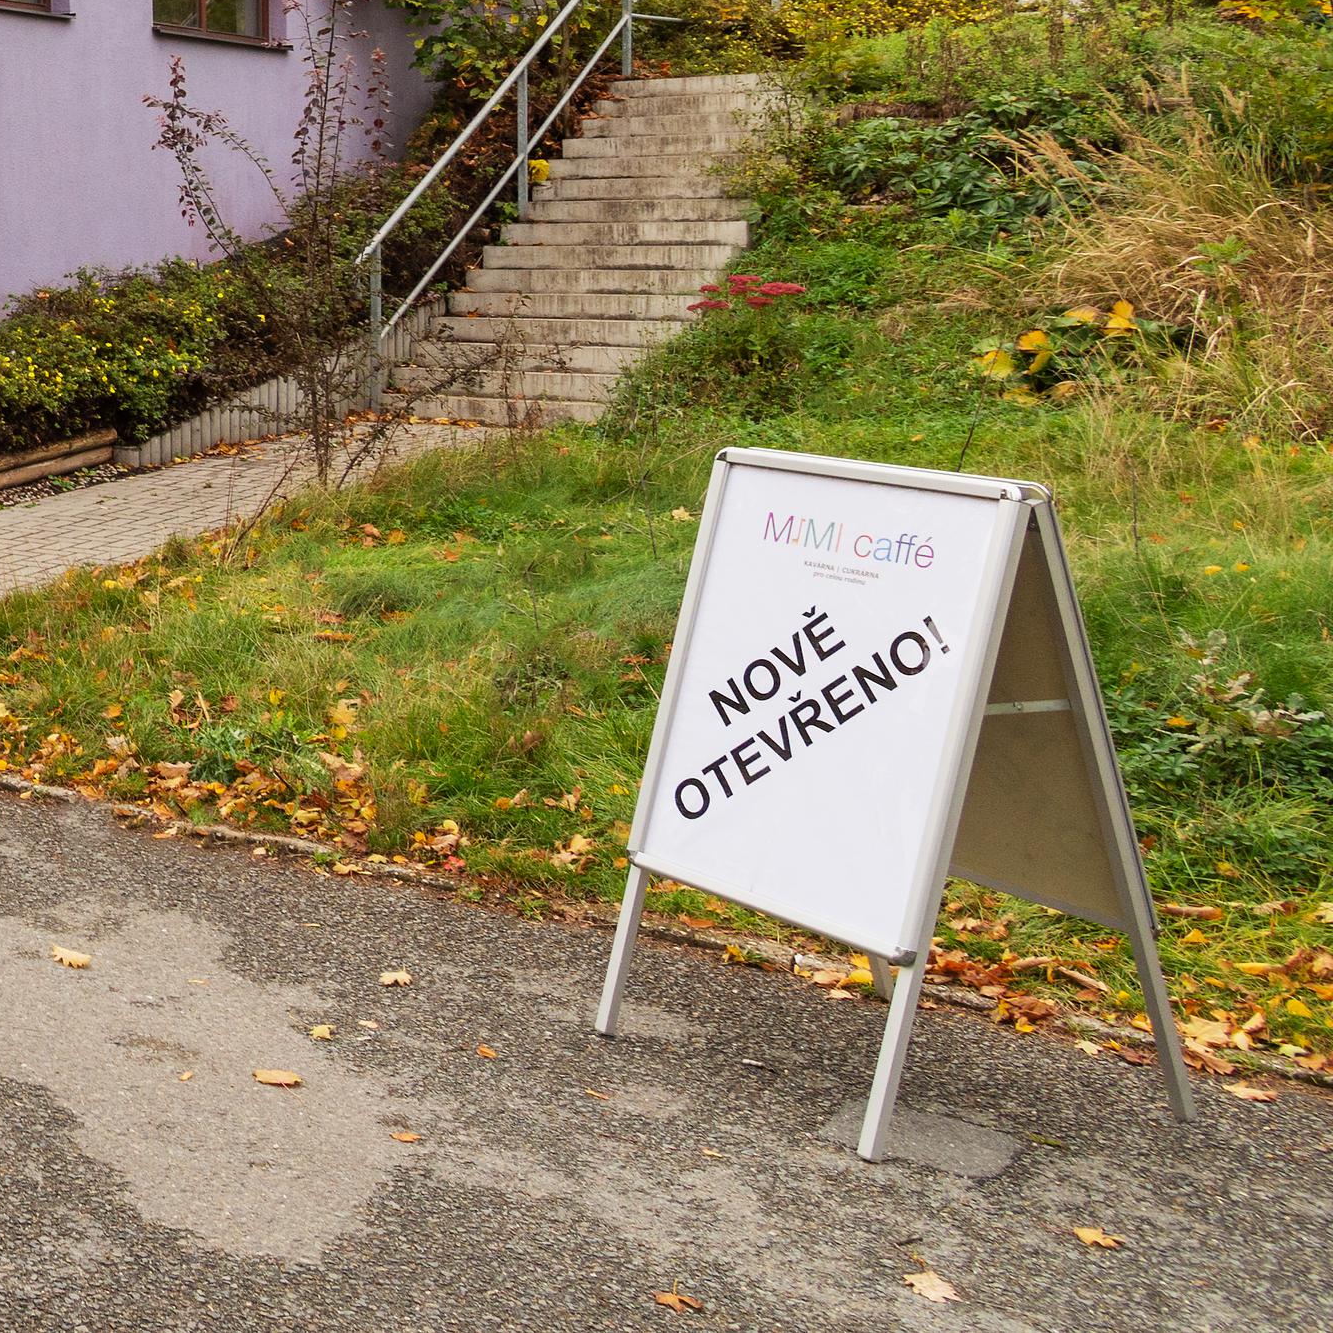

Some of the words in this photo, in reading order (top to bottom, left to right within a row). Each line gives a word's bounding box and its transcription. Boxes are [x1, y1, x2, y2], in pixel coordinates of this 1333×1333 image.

[763, 512, 843, 553] MIMI
[853, 533, 935, 568] caffé
[675, 616, 951, 821] OTEVŘENO!
[708, 605, 847, 727] NOVĚ
